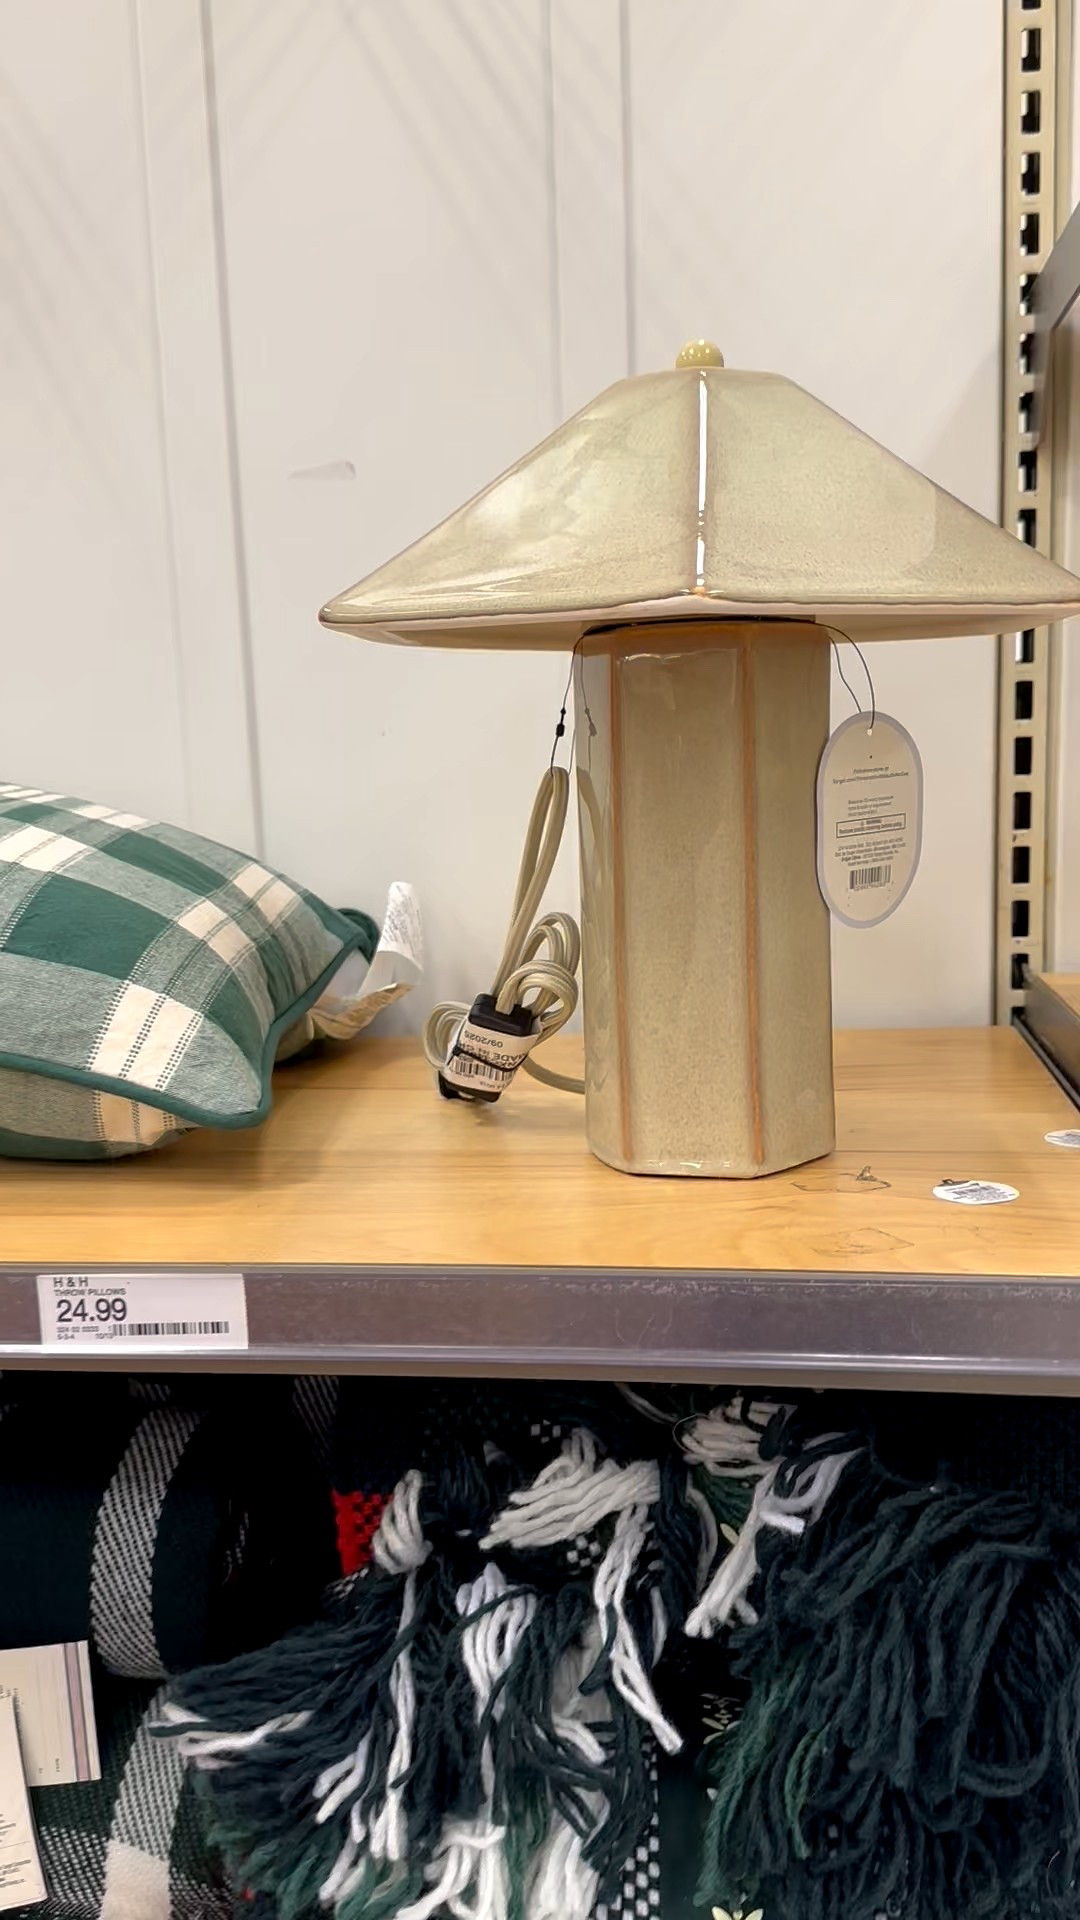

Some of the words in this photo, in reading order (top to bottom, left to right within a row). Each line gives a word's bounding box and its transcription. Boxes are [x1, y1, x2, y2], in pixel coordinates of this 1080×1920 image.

[464, 1030, 503, 1048] 09/2025
[53, 1277, 63, 1287] H
[67, 1277, 75, 1287] &
[79, 1276, 88, 1287] H
[88, 1288, 126, 1296] PILLOWS
[56, 1298, 127, 1322] 24.99
